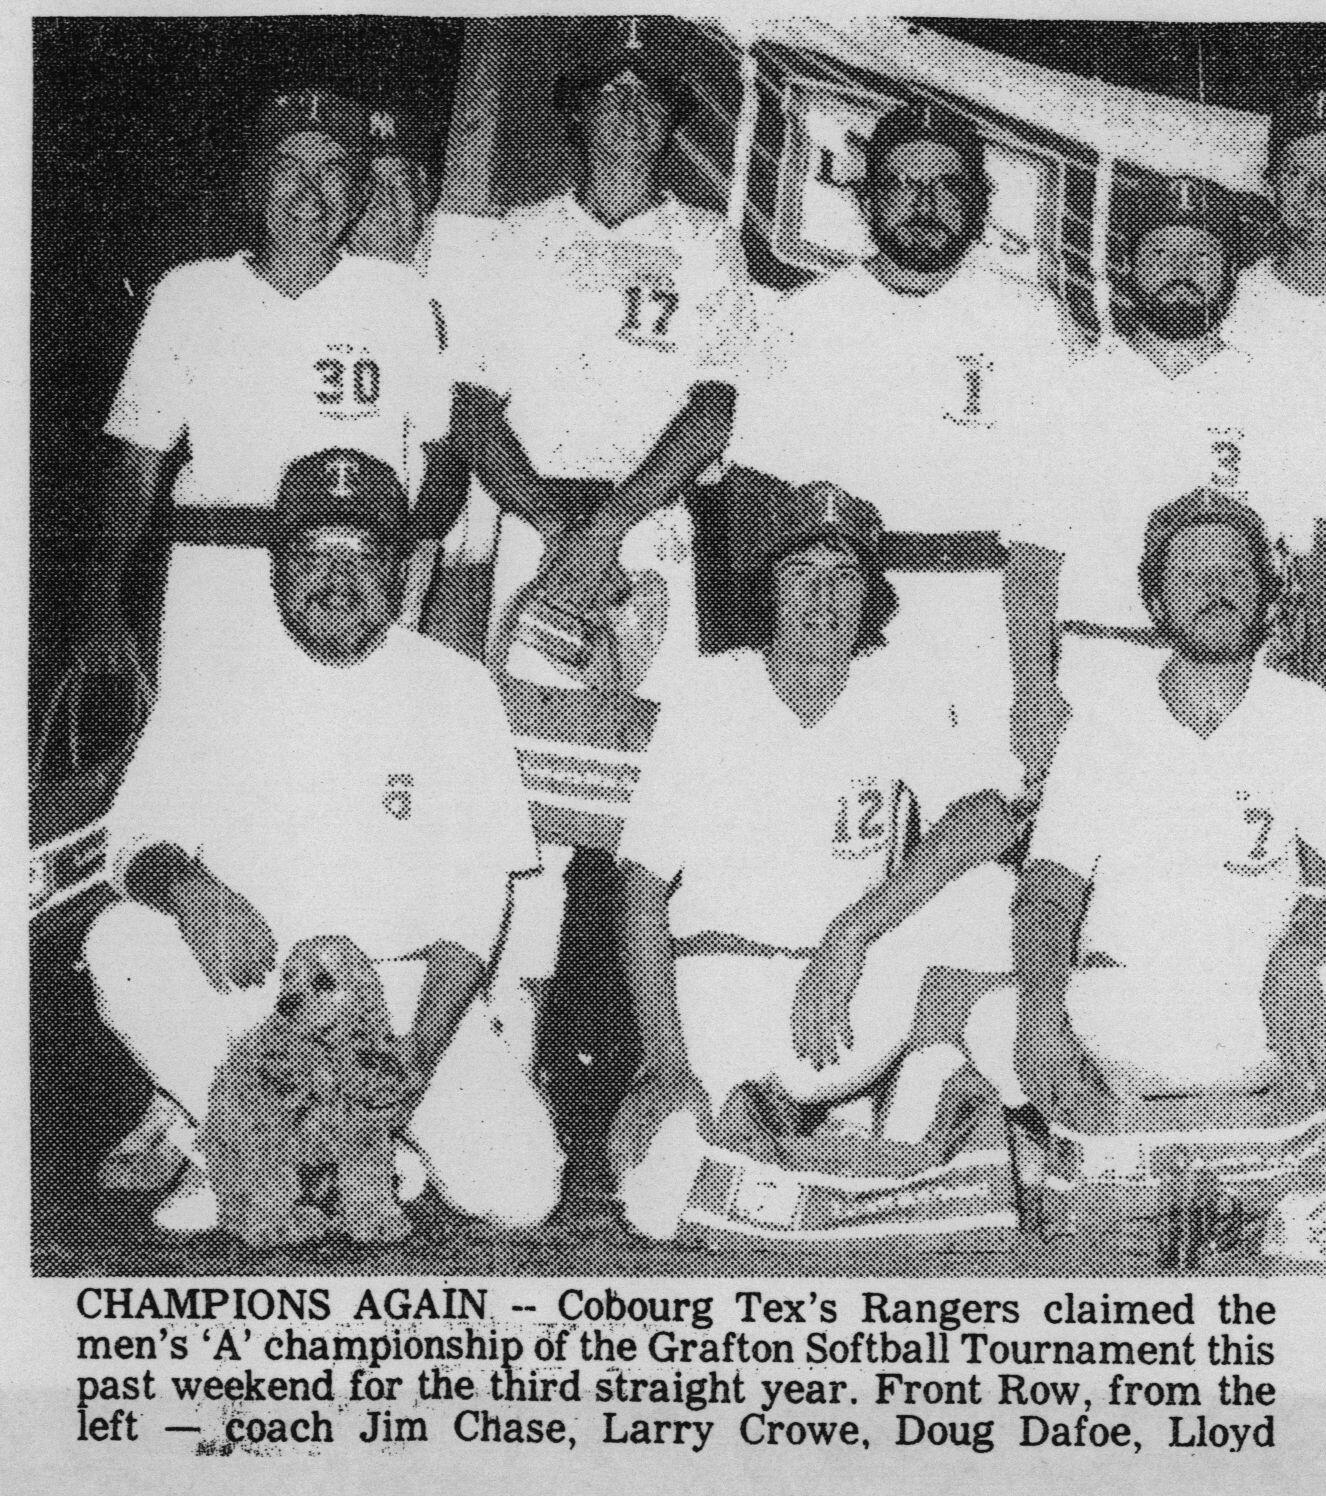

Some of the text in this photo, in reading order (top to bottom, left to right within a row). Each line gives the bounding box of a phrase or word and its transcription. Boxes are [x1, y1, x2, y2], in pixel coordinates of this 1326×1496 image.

[623, 285, 680, 336] 17
[312, 357, 382, 406] 30
[325, 457, 360, 499] T
[832, 788, 884, 844] 12
[1244, 807, 1275, 862] 7
[76, 1287, 331, 1321] CHAMPIONS
[353, 1287, 488, 1321] AGAIN
[557, 1287, 714, 1330] Cobourg
[735, 1291, 838, 1324] Tex's
[861, 1291, 1020, 1332] Rangers
[1043, 1292, 1195, 1325] claimed
[1218, 1293, 1276, 1326] the
[77, 1327, 189, 1361] men's
[263, 1327, 524, 1369] championship
[533, 1329, 571, 1362] of
[579, 1328, 638, 1362] the
[648, 1330, 795, 1364] Grafton
[806, 1330, 950, 1364] Softball
[960, 1332, 1196, 1366] Tournament
[1207, 1333, 1275, 1366] this
[76, 1366, 1276, 1413] past weekend for the third straight year. Front Row, from the
[76, 1408, 139, 1442] left
[225, 1409, 334, 1444] coach
[358, 1409, 429, 1444] Jim
[453, 1409, 577, 1450] Chase,
[602, 1411, 715, 1454] Larry
[739, 1412, 870, 1450] Crowe,
[895, 1414, 995, 1454] Doug
[1019, 1414, 1142, 1454] Dafoe,
[1168, 1414, 1276, 1453] Lloyd
